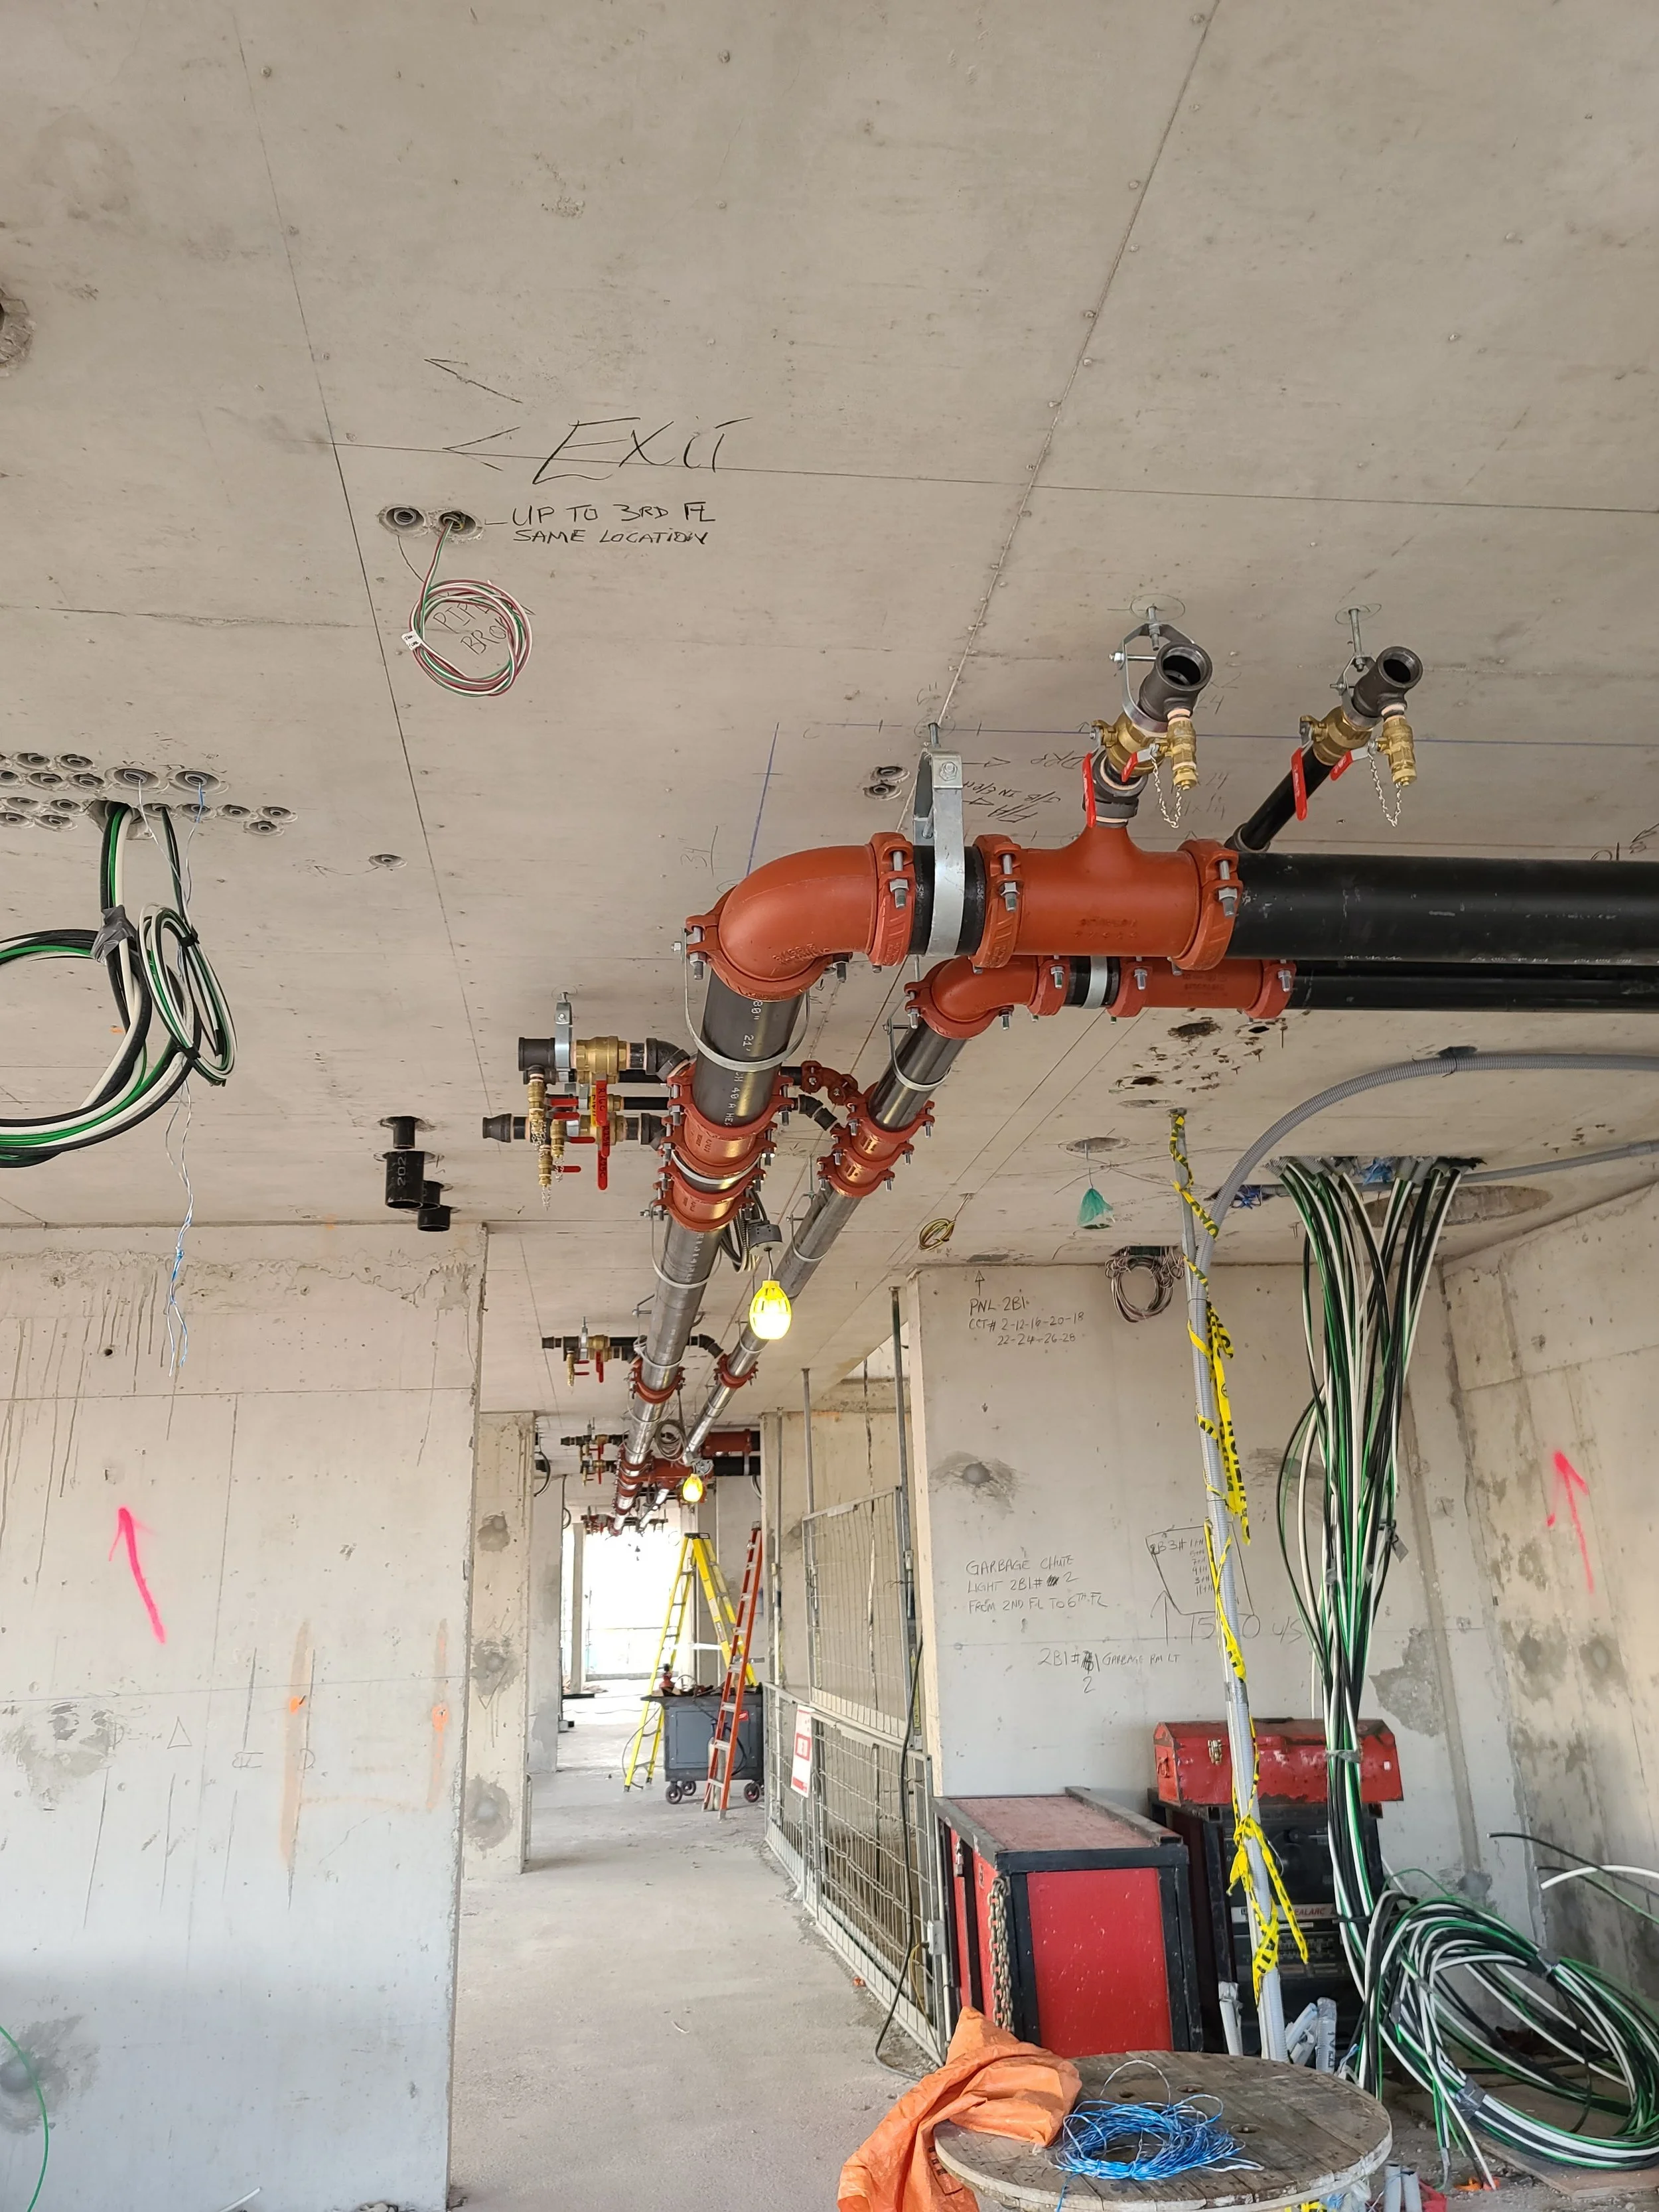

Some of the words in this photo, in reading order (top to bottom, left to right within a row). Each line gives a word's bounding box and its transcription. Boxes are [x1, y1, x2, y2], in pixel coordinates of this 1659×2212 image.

[512, 505, 555, 526] UP
[566, 504, 598, 522] TO
[613, 504, 669, 522] 3RD
[684, 502, 716, 522] FL
[513, 529, 586, 544] SAME
[751, 1000, 763, 1021] 80"
[397, 1153, 407, 1187] 202
[970, 1298, 996, 1315] PNL
[966, 1560, 1031, 1575] GARBAGE
[968, 1581, 1003, 1593] LIGHT
[1003, 1600, 1023, 1611] 2ND
[1029, 1597, 1044, 1609] FL
[1167, 1654, 1180, 1662] LT
[1082, 1676, 1095, 1694] 2
[1295, 1907, 1326, 1915] EALARC
